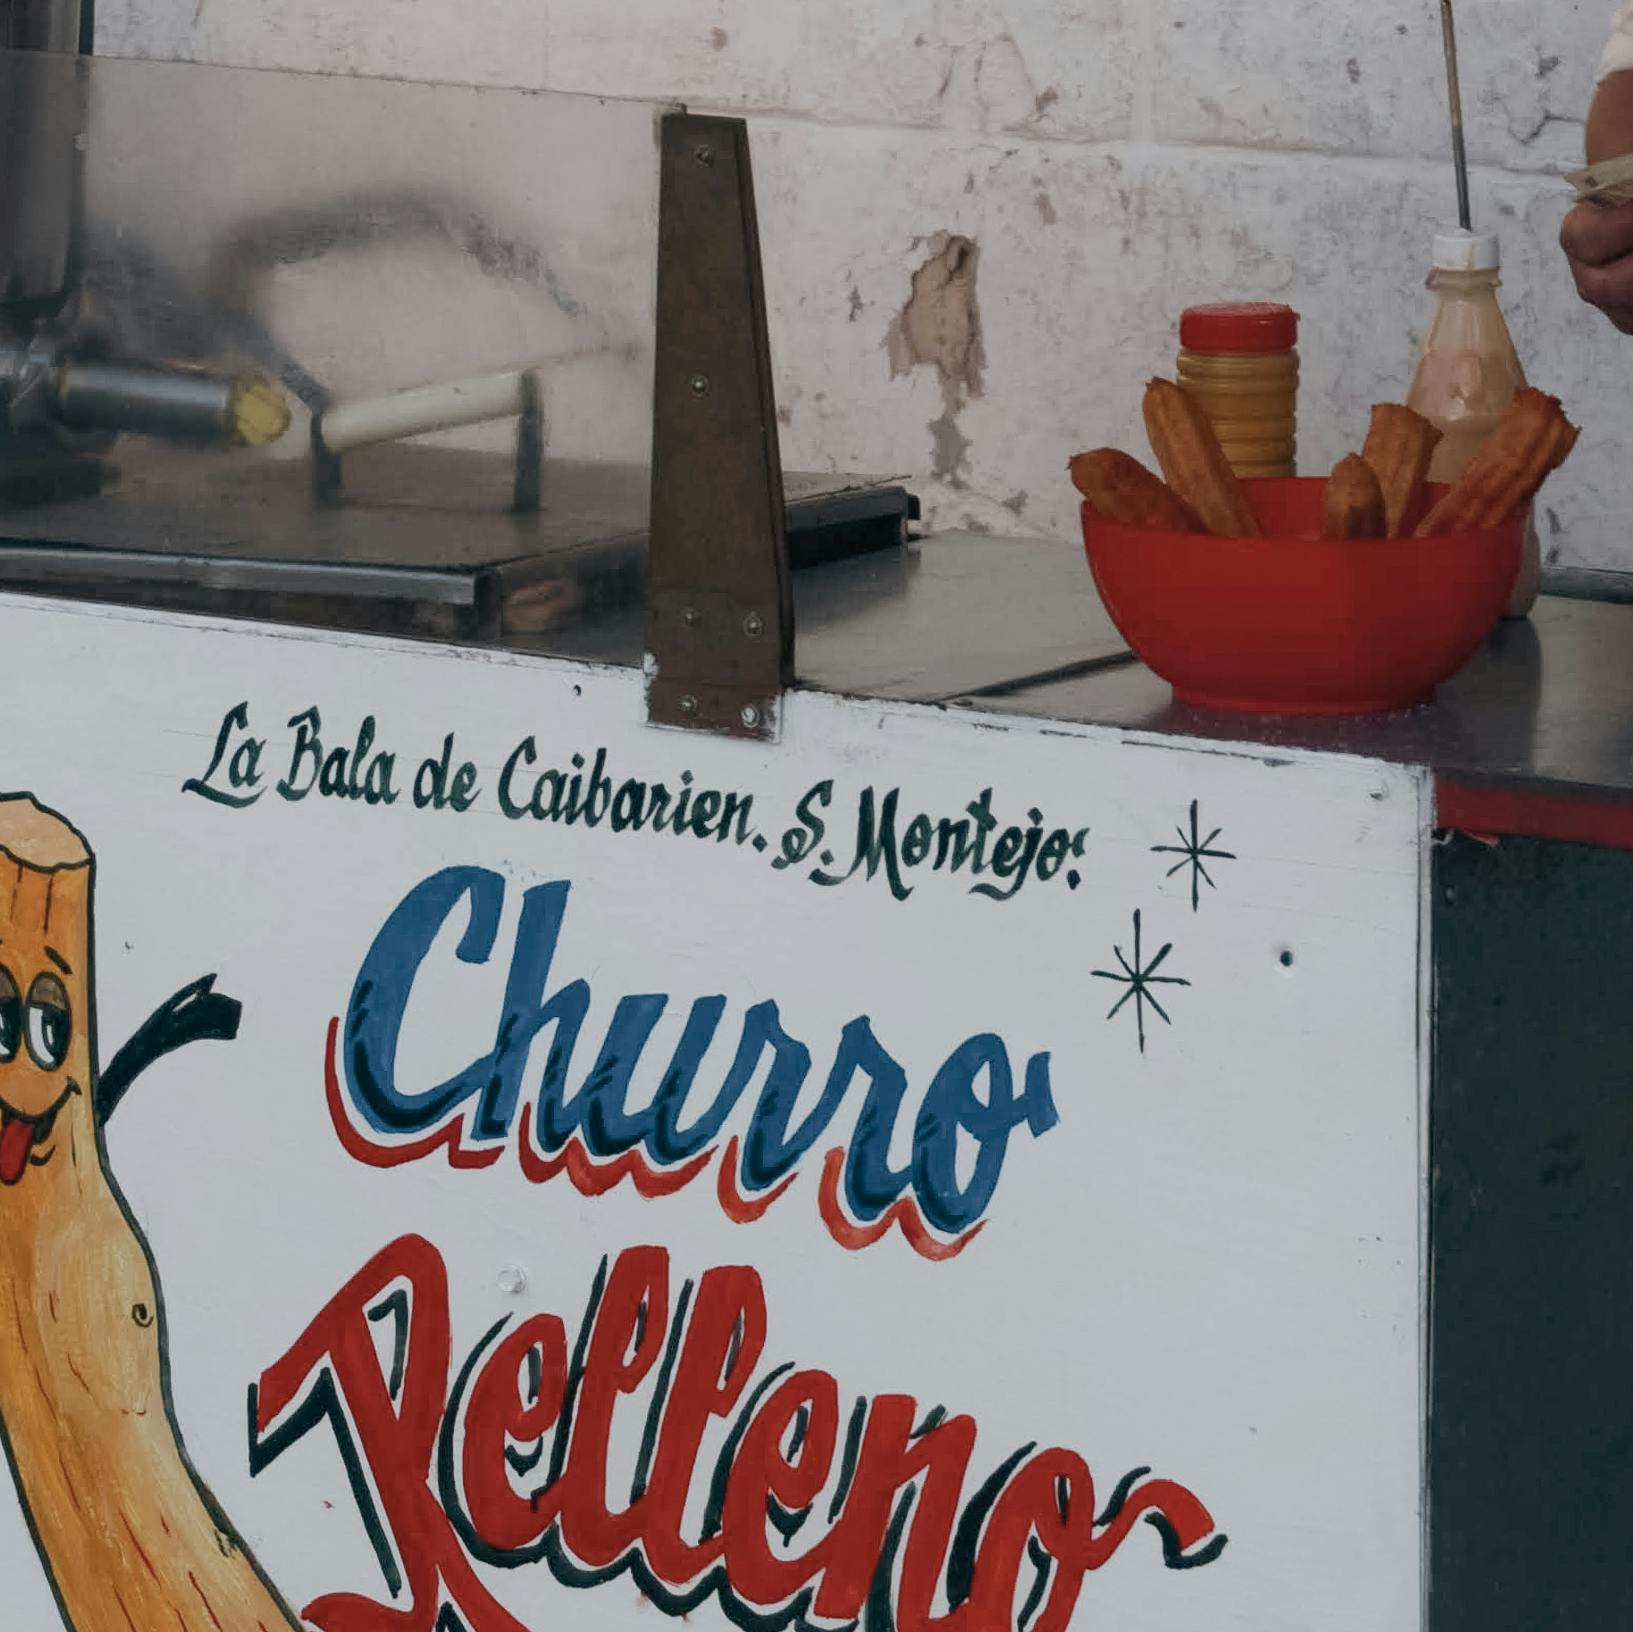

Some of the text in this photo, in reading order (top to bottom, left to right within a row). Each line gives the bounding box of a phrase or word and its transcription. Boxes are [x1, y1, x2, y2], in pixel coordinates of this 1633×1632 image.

[181, 700, 267, 809] La
[276, 705, 401, 806] Bala
[412, 731, 482, 813] de
[325, 865, 1060, 1262] Churro
[248, 1232, 1228, 1632] Relleno
